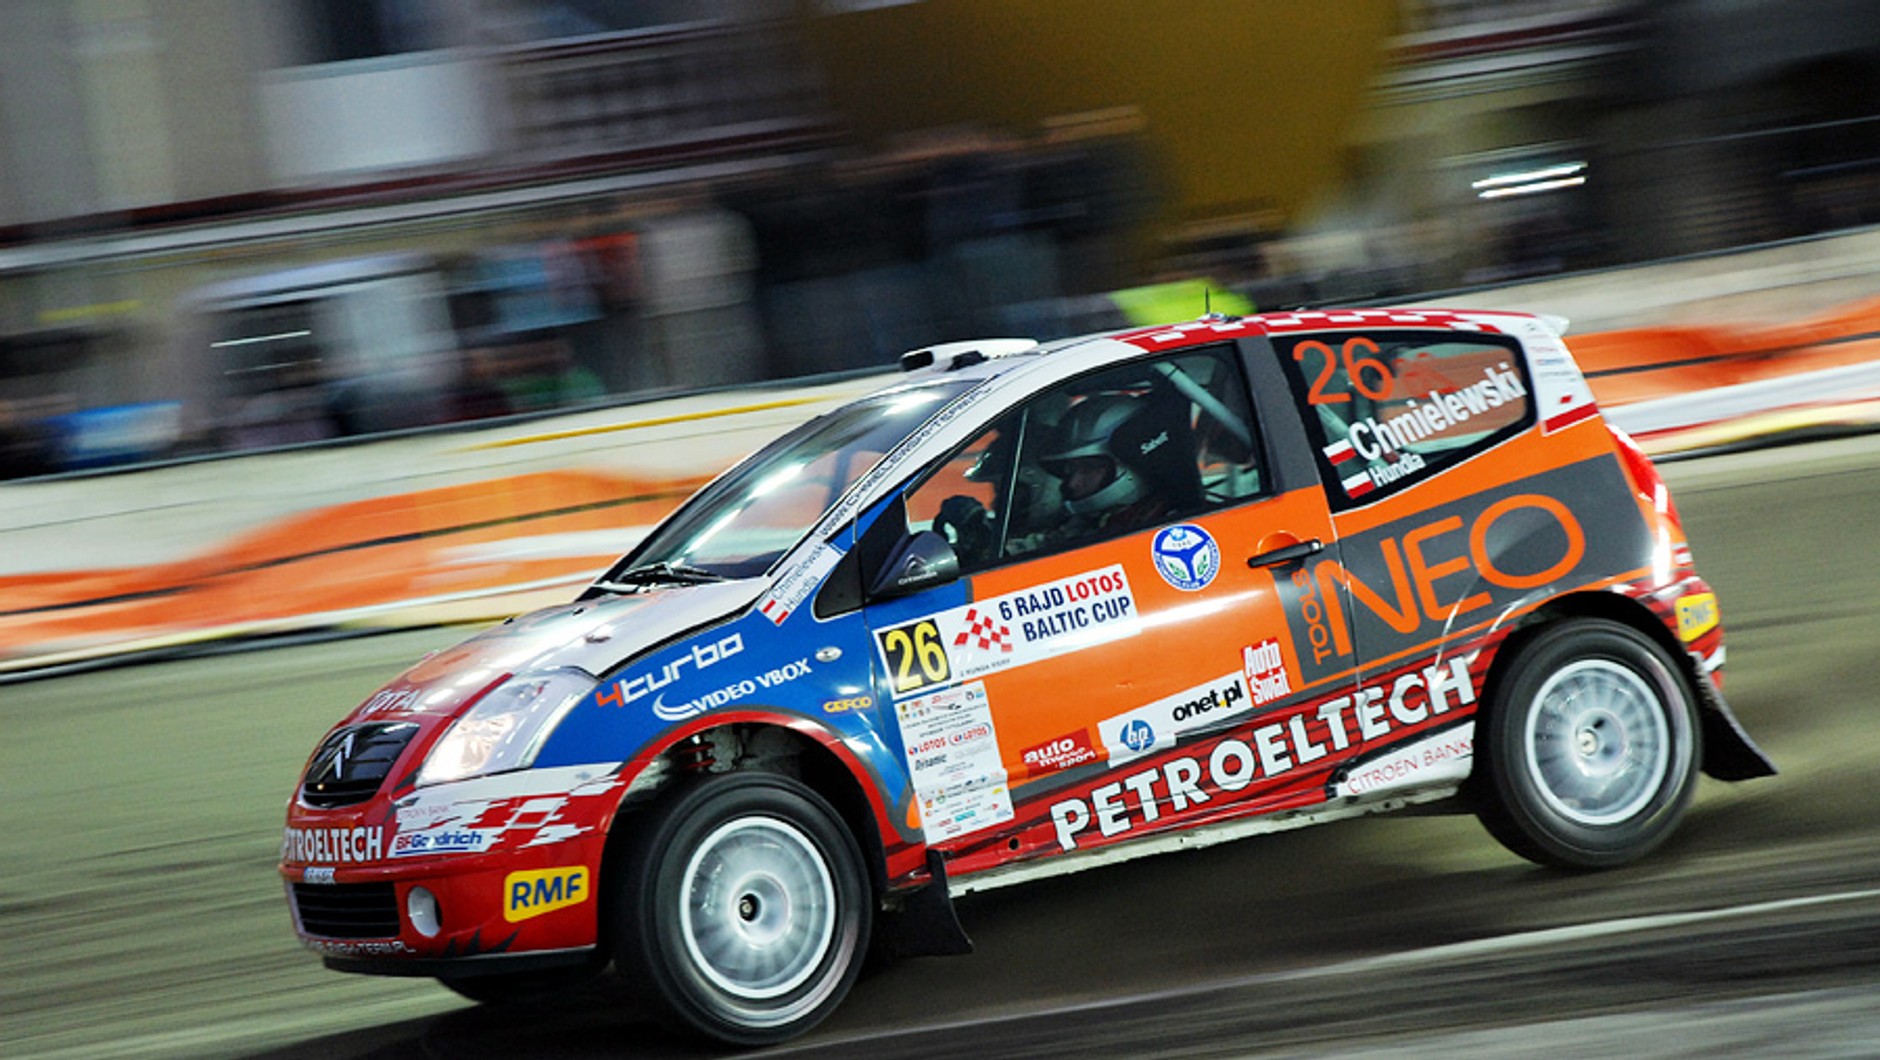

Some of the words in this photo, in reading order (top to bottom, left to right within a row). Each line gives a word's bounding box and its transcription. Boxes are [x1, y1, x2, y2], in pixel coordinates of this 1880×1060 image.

[1293, 337, 1394, 405] 26
[1349, 362, 1527, 460] Chmielewski
[1367, 453, 1427, 487] Hundla
[998, 601, 1013, 621] 6
[1014, 587, 1064, 617] RAJD
[1065, 571, 1124, 602] LOTOS
[1315, 493, 1586, 657] NEO
[1022, 605, 1090, 643] BALTIC
[1091, 596, 1131, 624] CUP
[1291, 568, 1332, 665] TOOLS
[594, 632, 745, 708] 4turbo
[885, 620, 950, 692] 26
[690, 678, 755, 714] VIDEO
[756, 657, 813, 689] VBOX
[1172, 680, 1243, 722] onet.pl
[1024, 738, 1075, 764] auto
[1050, 655, 1477, 851] PETROELTECH
[395, 830, 483, 850] BFGodrich
[510, 873, 582, 911] RMF
